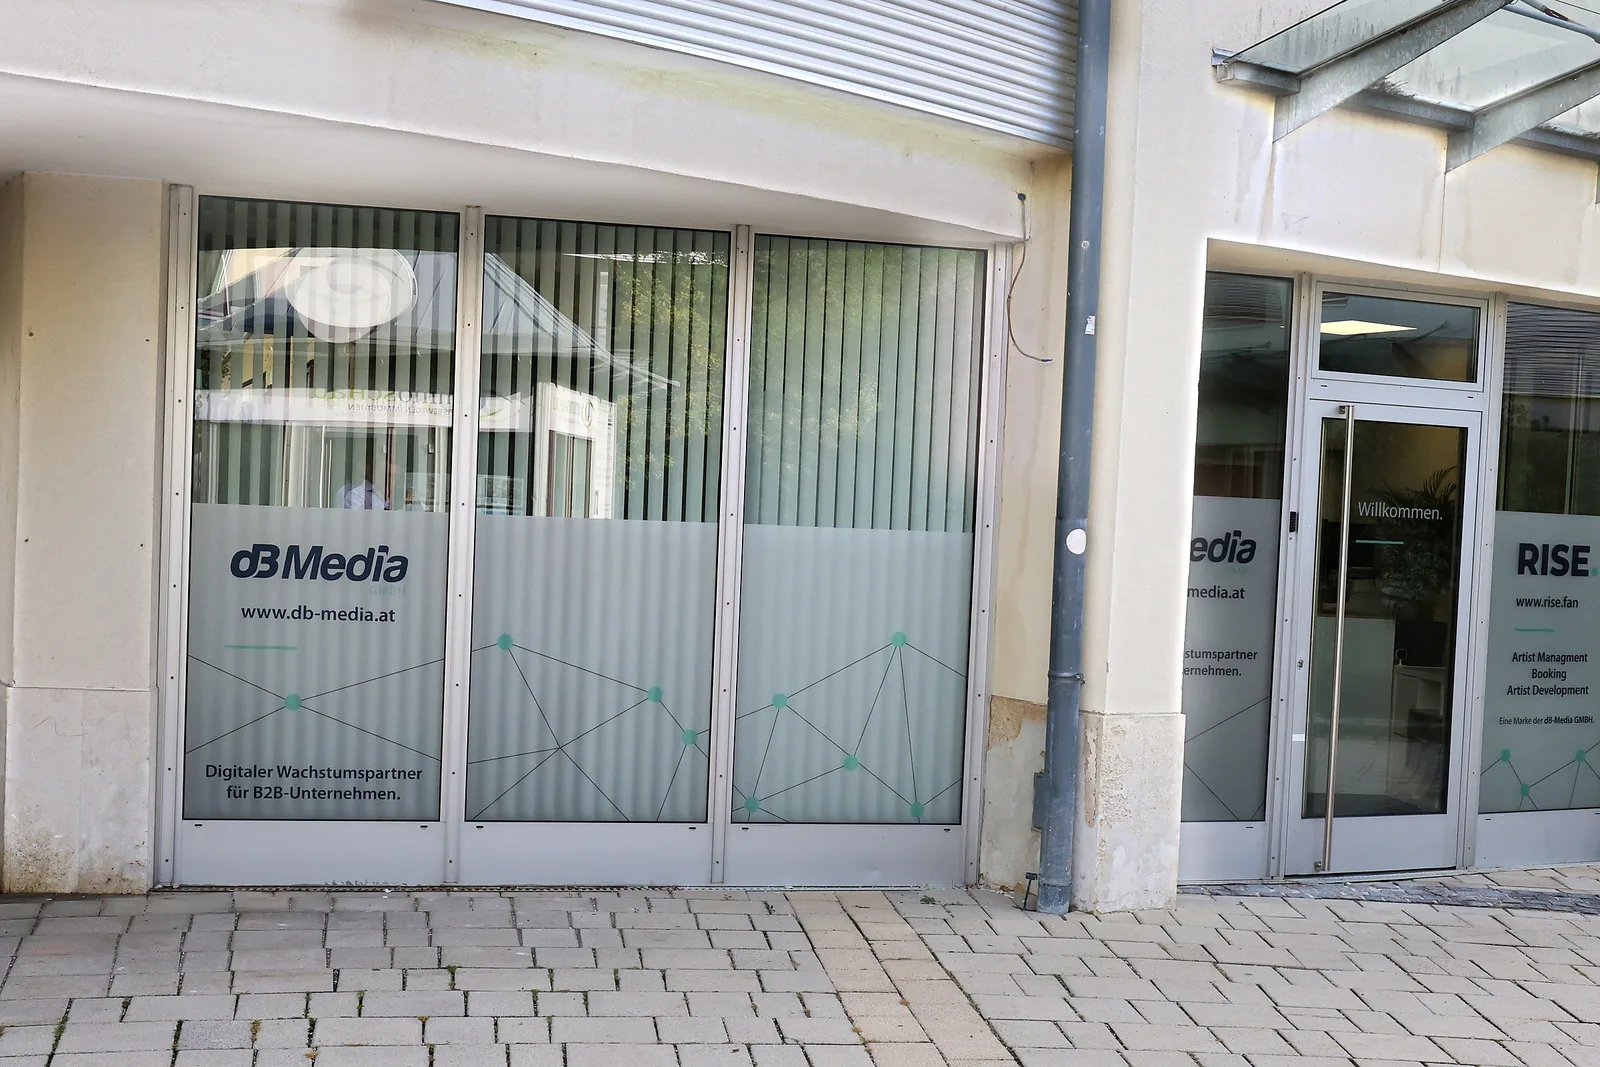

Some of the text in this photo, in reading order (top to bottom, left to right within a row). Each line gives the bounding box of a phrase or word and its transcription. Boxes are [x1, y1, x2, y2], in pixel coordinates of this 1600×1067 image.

[1358, 501, 1443, 520] Willkommen.
[1516, 596, 1579, 608] www.rise.fan
[241, 605, 396, 622] www.db-media.at
[1512, 652, 1588, 665] Artist Managment
[1531, 668, 1567, 681] Booking
[1506, 685, 1589, 698] Artist Development
[1499, 715, 1595, 725] Eine Marke der dB-Media GMBH.
[205, 764, 423, 782] Digitaler Wachstumspartner
[226, 786, 401, 801] für B2B-Unternehmen.
